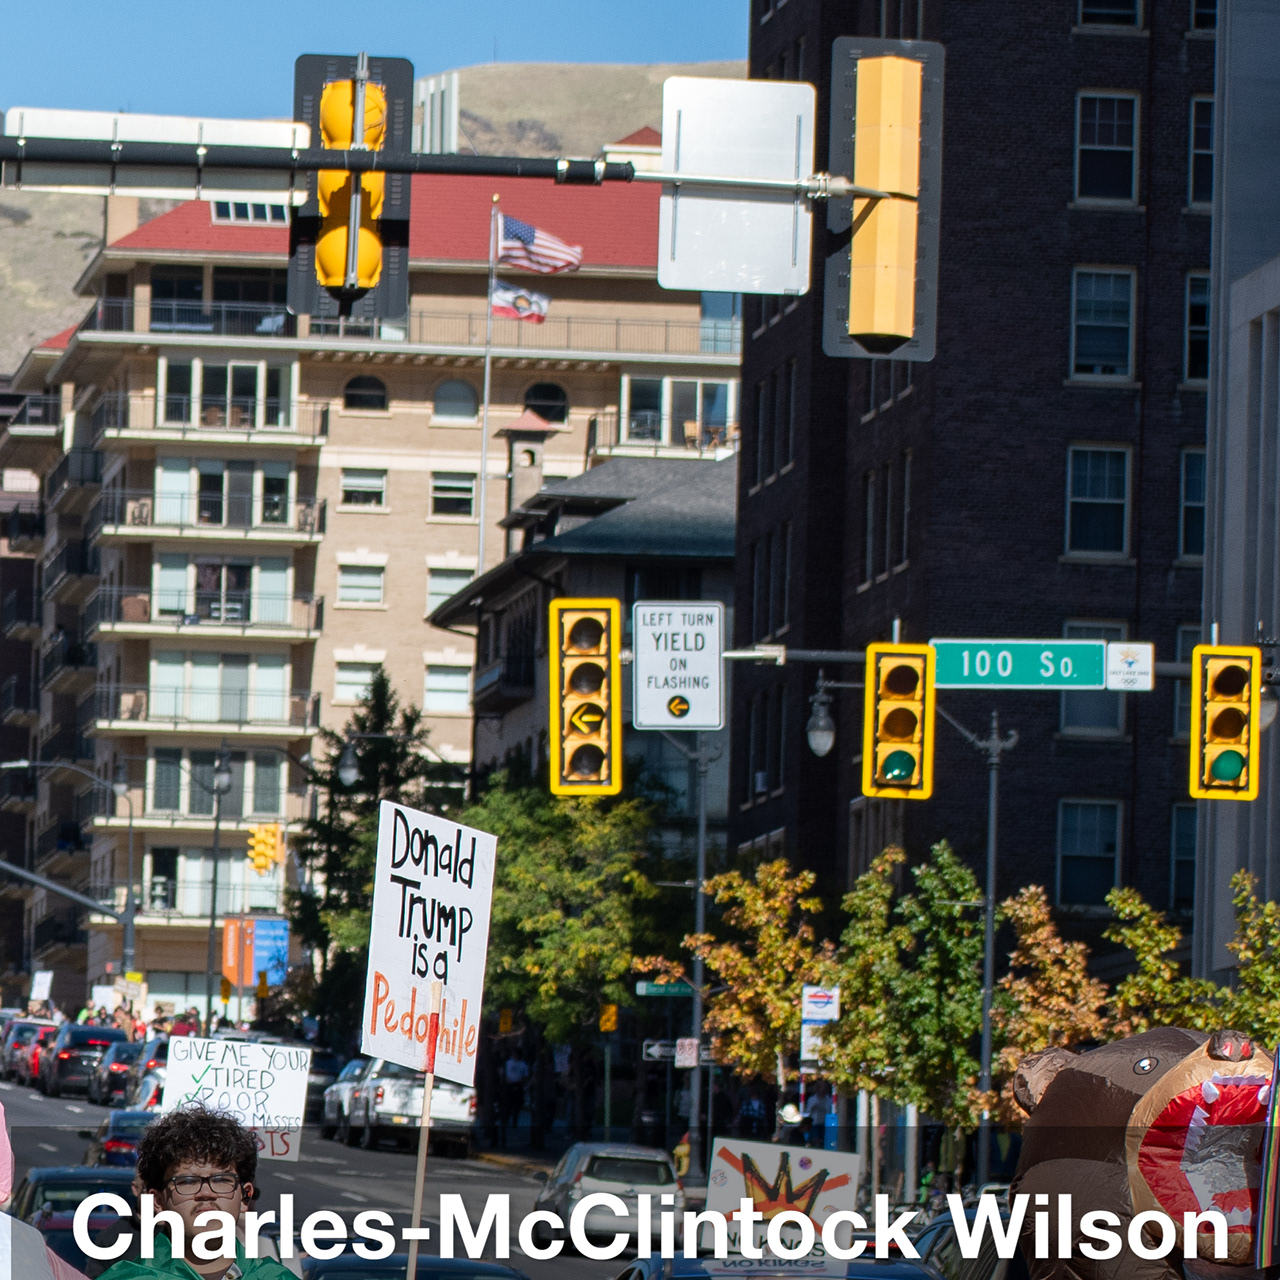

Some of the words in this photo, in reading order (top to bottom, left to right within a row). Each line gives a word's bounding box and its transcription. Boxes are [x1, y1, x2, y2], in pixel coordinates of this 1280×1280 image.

[642, 613, 673, 626] LEFT
[681, 613, 714, 626] TURN
[651, 632, 705, 652] YIELD
[669, 658, 687, 671] ON
[961, 650, 1013, 677] 100
[1039, 650, 1078, 678] So.
[646, 676, 710, 689] FLASHING
[390, 807, 477, 890] Donald
[389, 873, 474, 963] Trump
[411, 934, 429, 979] is
[433, 950, 448, 986] a
[173, 1039, 217, 1061] GIVE
[220, 1043, 252, 1067] ME
[262, 1047, 309, 1072] YOUR
[210, 1067, 276, 1090] TIRED
[201, 1087, 269, 1114] POOR
[252, 1112, 301, 1134] MASSES
